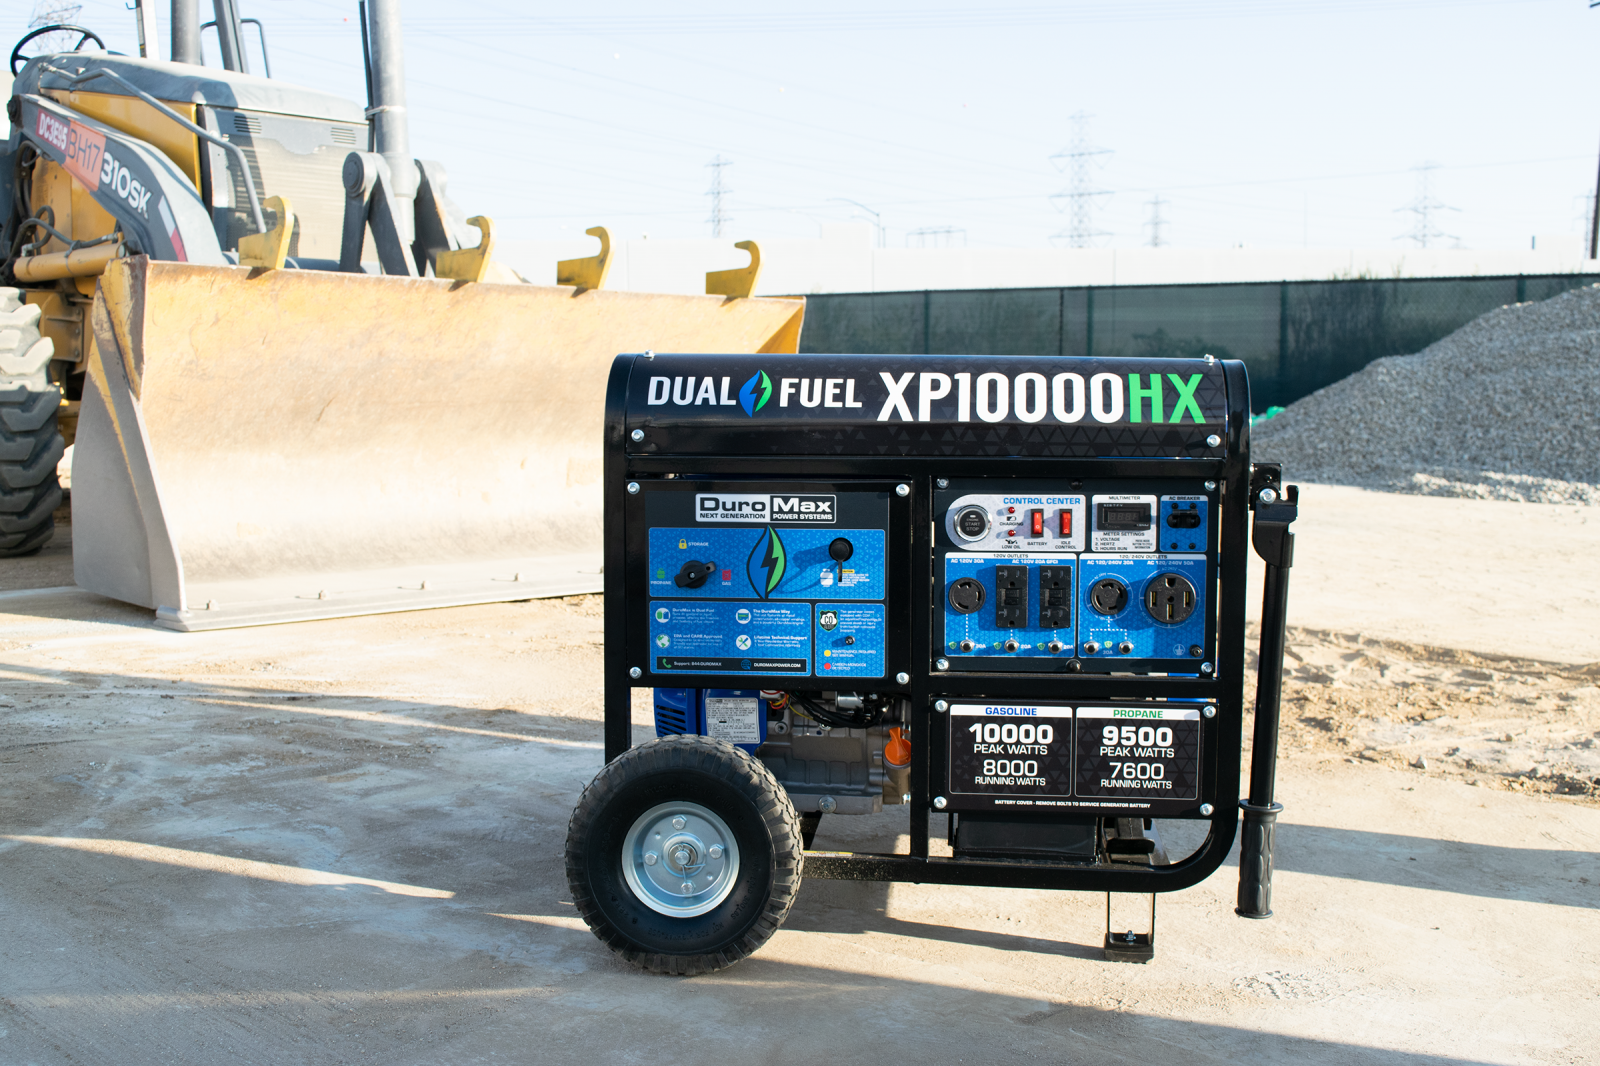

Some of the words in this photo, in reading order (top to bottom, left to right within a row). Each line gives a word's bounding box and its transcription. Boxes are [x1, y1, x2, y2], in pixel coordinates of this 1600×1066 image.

[39, 113, 68, 150] DC3E95
[68, 129, 101, 173] BH17
[101, 151, 152, 218] 310SK
[647, 376, 737, 406] DUAL
[780, 378, 862, 408] FUEL
[876, 371, 1206, 423] XP10000HX
[1003, 497, 1044, 505] CONTROL
[1046, 497, 1081, 505] CENTER
[824, 616, 833, 624] CO
[985, 707, 1037, 716] GASOLINE
[1113, 709, 1164, 719] PROPANE
[969, 723, 1054, 744] 10000
[1102, 725, 1173, 747] 9500
[973, 744, 1005, 754] PEAK
[1006, 744, 1048, 755] WATTS
[1100, 747, 1131, 757] PEAK
[1132, 748, 1175, 758] WATTS
[983, 759, 1038, 777] 8000
[1109, 762, 1165, 779] 7600
[974, 776, 1015, 785] RUNNING
[1016, 777, 1046, 786] WATTS
[1100, 779, 1142, 788] RUNNING
[1142, 781, 1173, 789] WATTS
